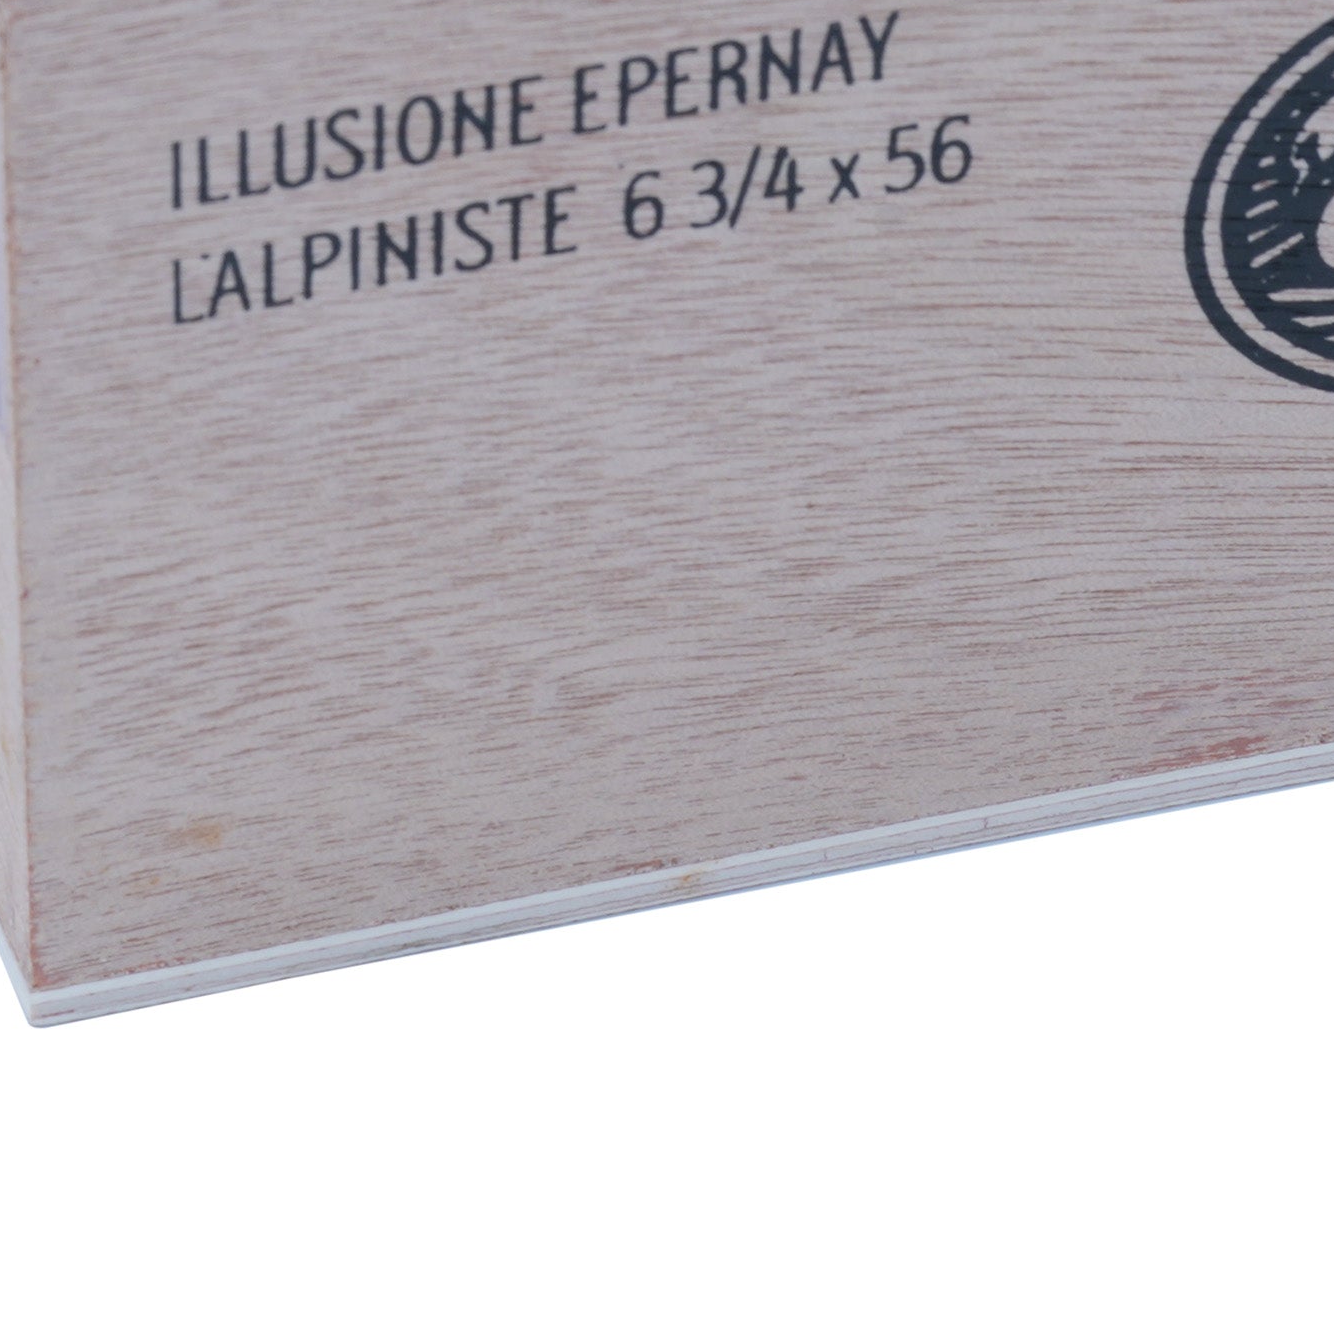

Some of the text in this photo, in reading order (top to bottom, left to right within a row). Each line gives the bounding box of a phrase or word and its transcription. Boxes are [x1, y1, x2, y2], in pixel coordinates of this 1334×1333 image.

[171, 9, 900, 210] ILLUSIONE EPERNAY
[623, 169, 666, 240] 6
[689, 143, 806, 230] 3/4
[883, 113, 974, 195] 56
